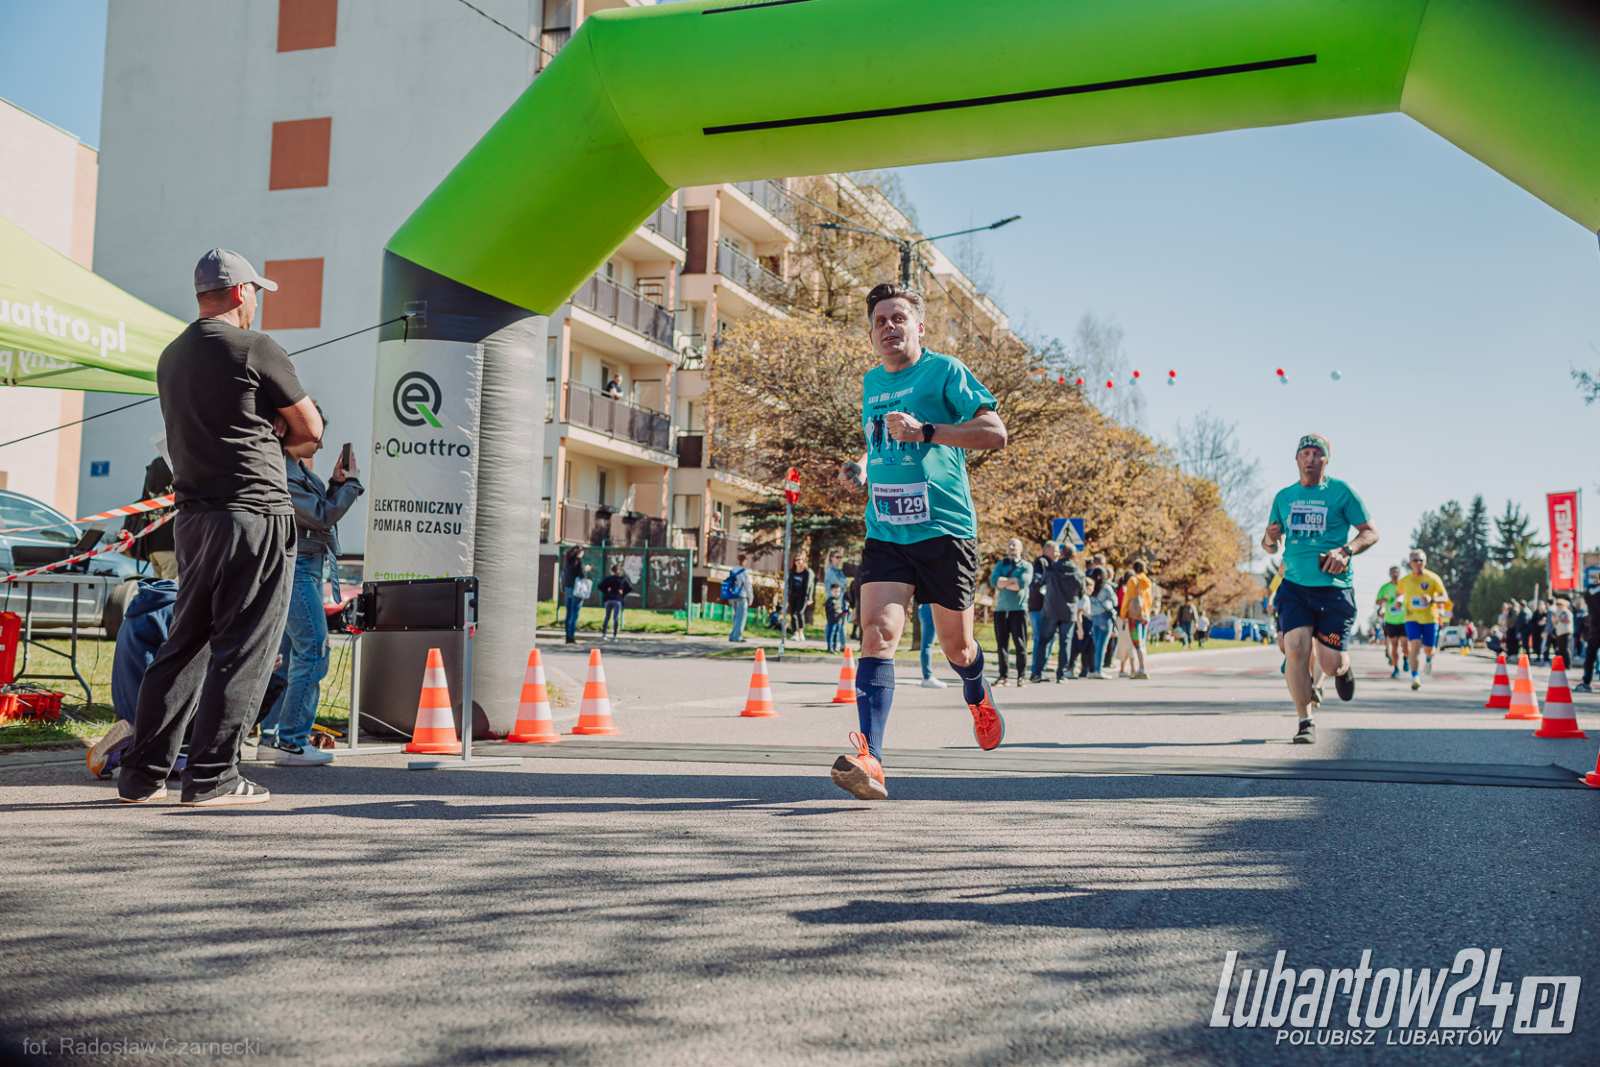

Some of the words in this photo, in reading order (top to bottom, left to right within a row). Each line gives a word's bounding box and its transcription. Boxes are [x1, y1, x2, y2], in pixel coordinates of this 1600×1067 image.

[374, 499, 463, 515] ELEKTRONICZNY
[896, 497, 924, 513] 129
[373, 519, 412, 532] POMIAR
[416, 521, 462, 535] CZASU
